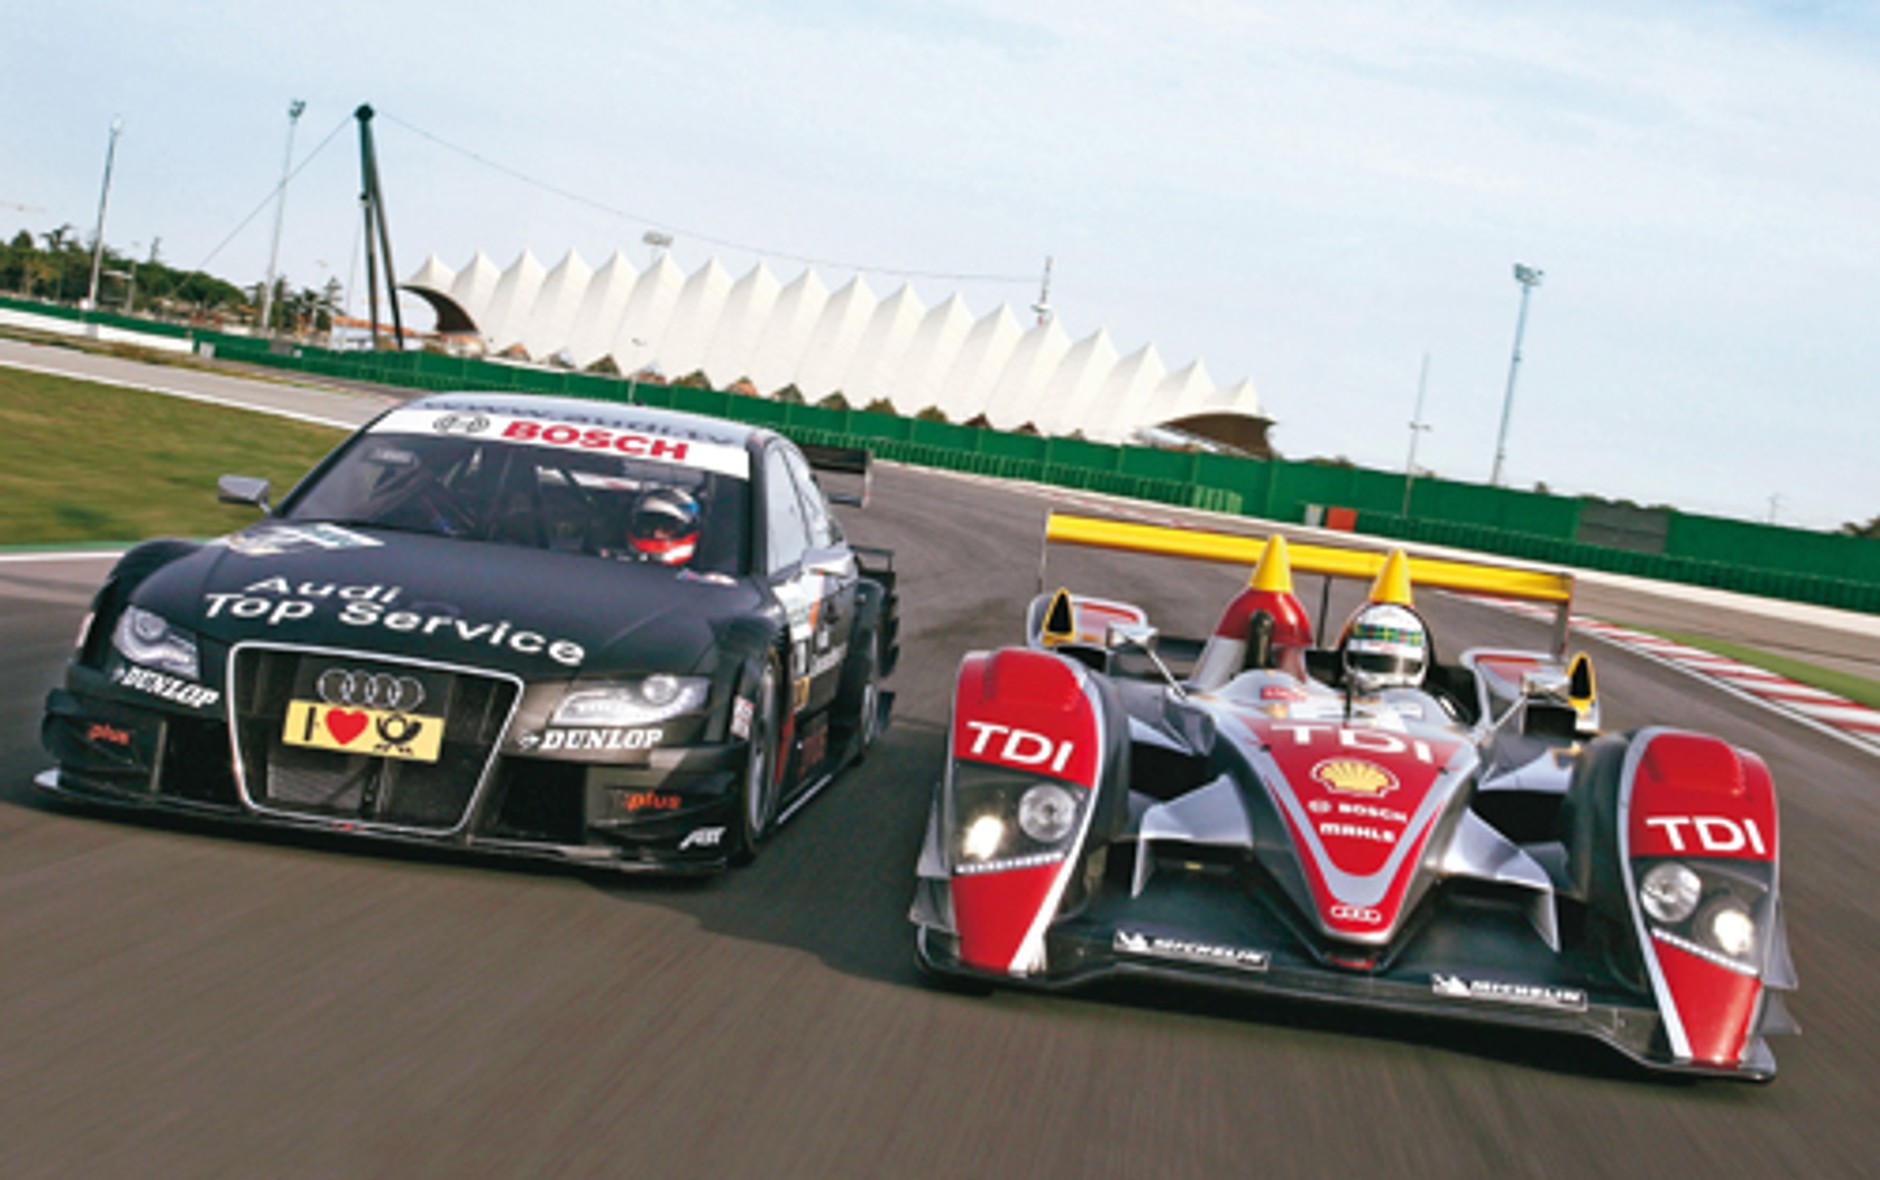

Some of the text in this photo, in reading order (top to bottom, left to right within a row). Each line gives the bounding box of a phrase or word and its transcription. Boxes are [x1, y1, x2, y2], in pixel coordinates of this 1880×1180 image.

[502, 420, 689, 460] BOSCH
[245, 576, 402, 603] Audi
[205, 593, 586, 666] Top Service
[121, 666, 219, 708] DUNLOP
[540, 728, 664, 750] DUNLOP
[967, 721, 1073, 773] TDI
[1270, 724, 1433, 764] TDI
[1338, 803, 1408, 823] BOSCH
[1646, 817, 1766, 854] TDI
